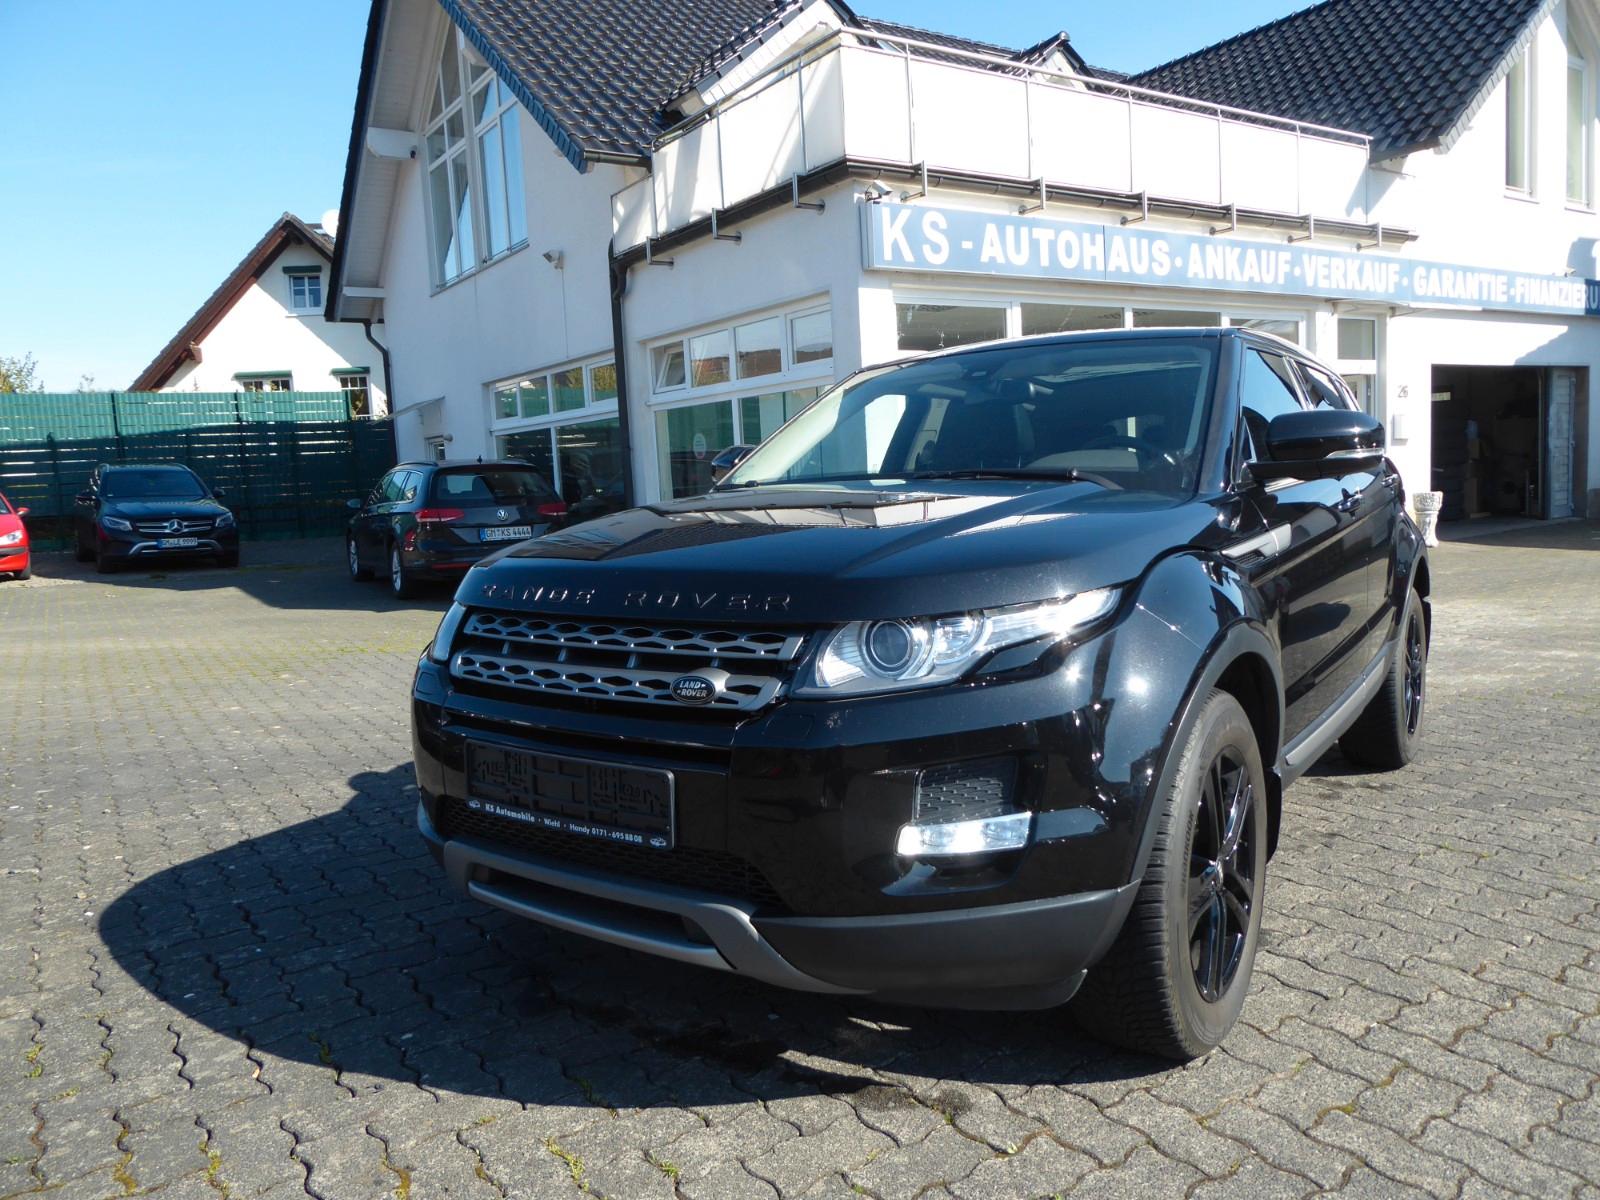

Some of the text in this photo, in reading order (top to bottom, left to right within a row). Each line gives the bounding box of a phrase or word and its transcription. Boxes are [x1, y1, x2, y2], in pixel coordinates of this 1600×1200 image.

[880, 206, 951, 266] KS
[980, 222, 1172, 277] AUTOHAUS
[1187, 242, 1292, 285] ANKAUF
[1302, 253, 1400, 294] VERKAUF
[1412, 265, 1508, 303] GARANTIE
[1514, 275, 1600, 310] FINANZIERU
[501, 528, 511, 537] KS
[679, 680, 701, 689] LAND
[681, 689, 708, 697] ROVER
[485, 803, 495, 813] KS
[496, 806, 535, 823] Automobile
[544, 818, 561, 828] Wiehl
[569, 823, 590, 835] Handy
